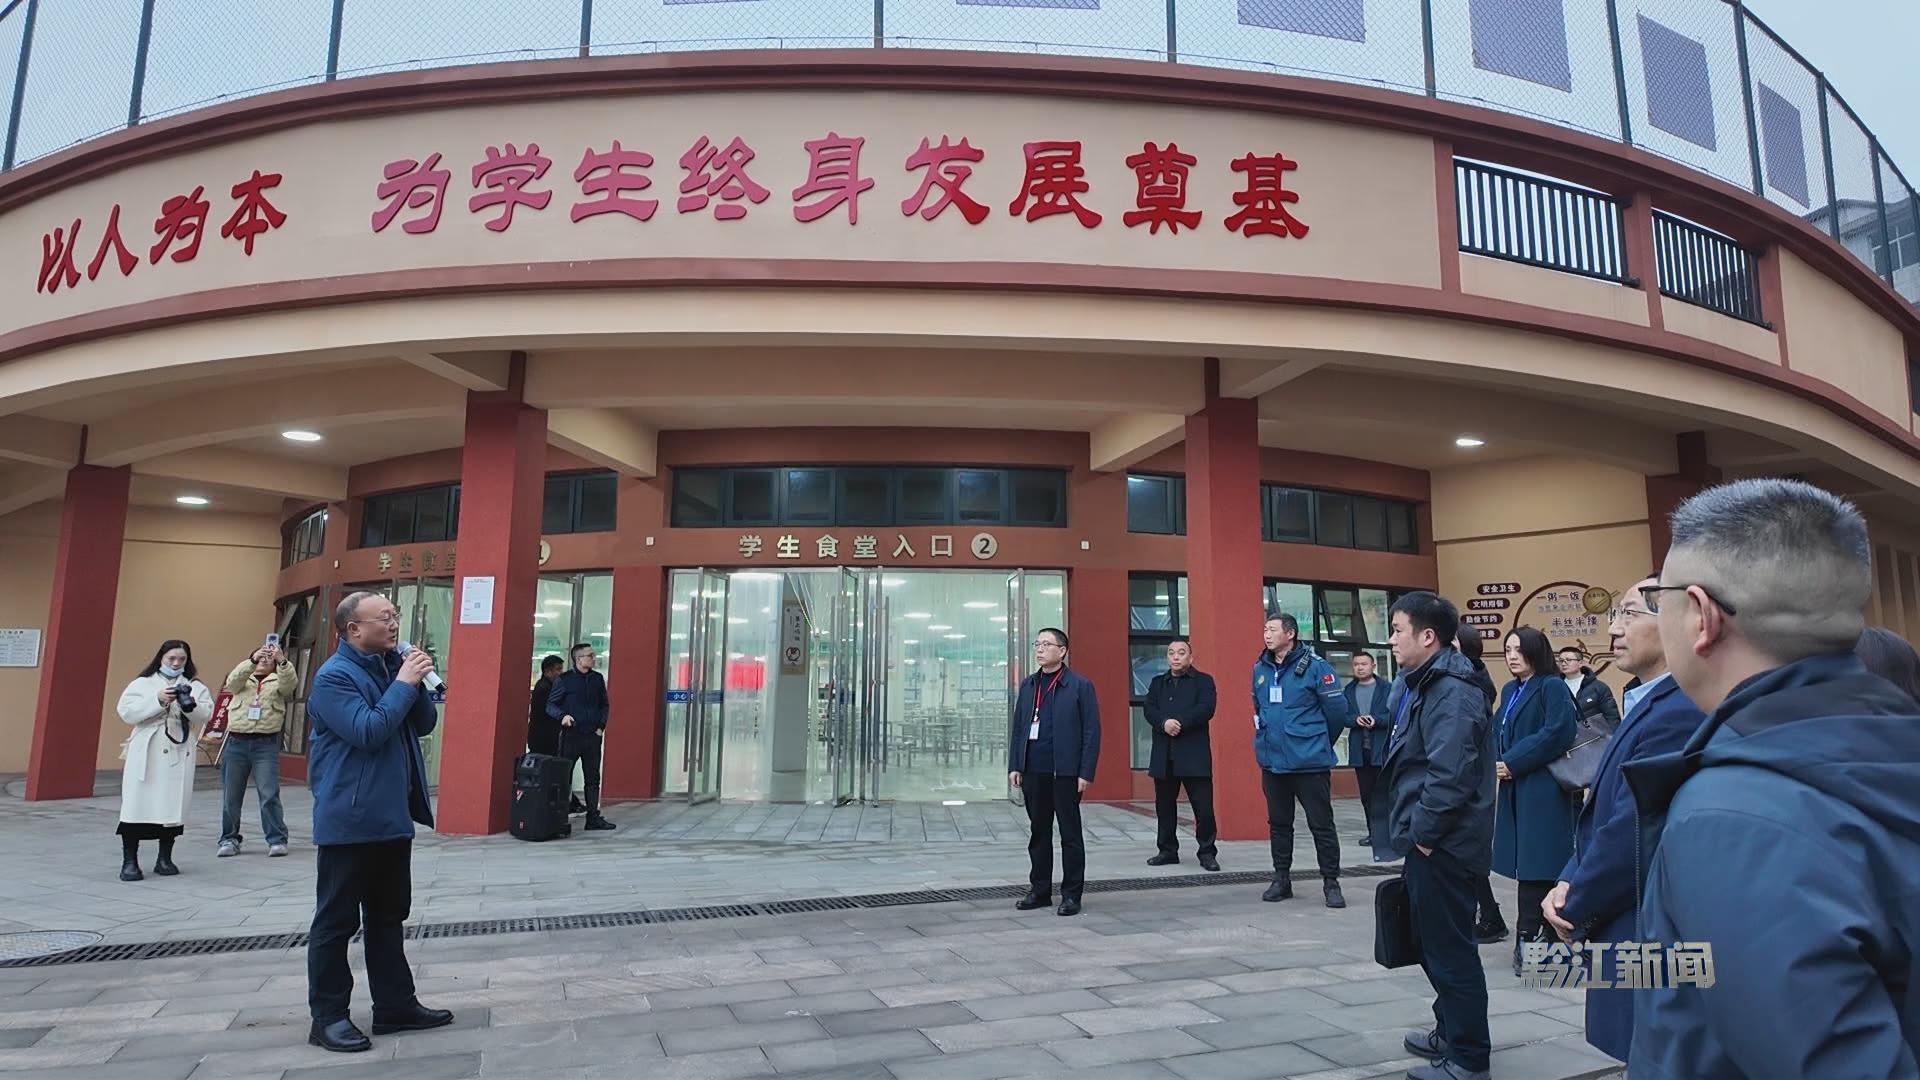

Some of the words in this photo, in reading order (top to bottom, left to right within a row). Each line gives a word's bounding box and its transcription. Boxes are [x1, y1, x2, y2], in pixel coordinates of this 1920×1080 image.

[37, 169, 287, 294] 以人为本
[371, 131, 1310, 240] 为学生终身发展奠基
[739, 534, 954, 559] 学生食堂入口
[1482, 584, 1516, 593] 安全卫生
[1472, 598, 1504, 608] 文明用餐
